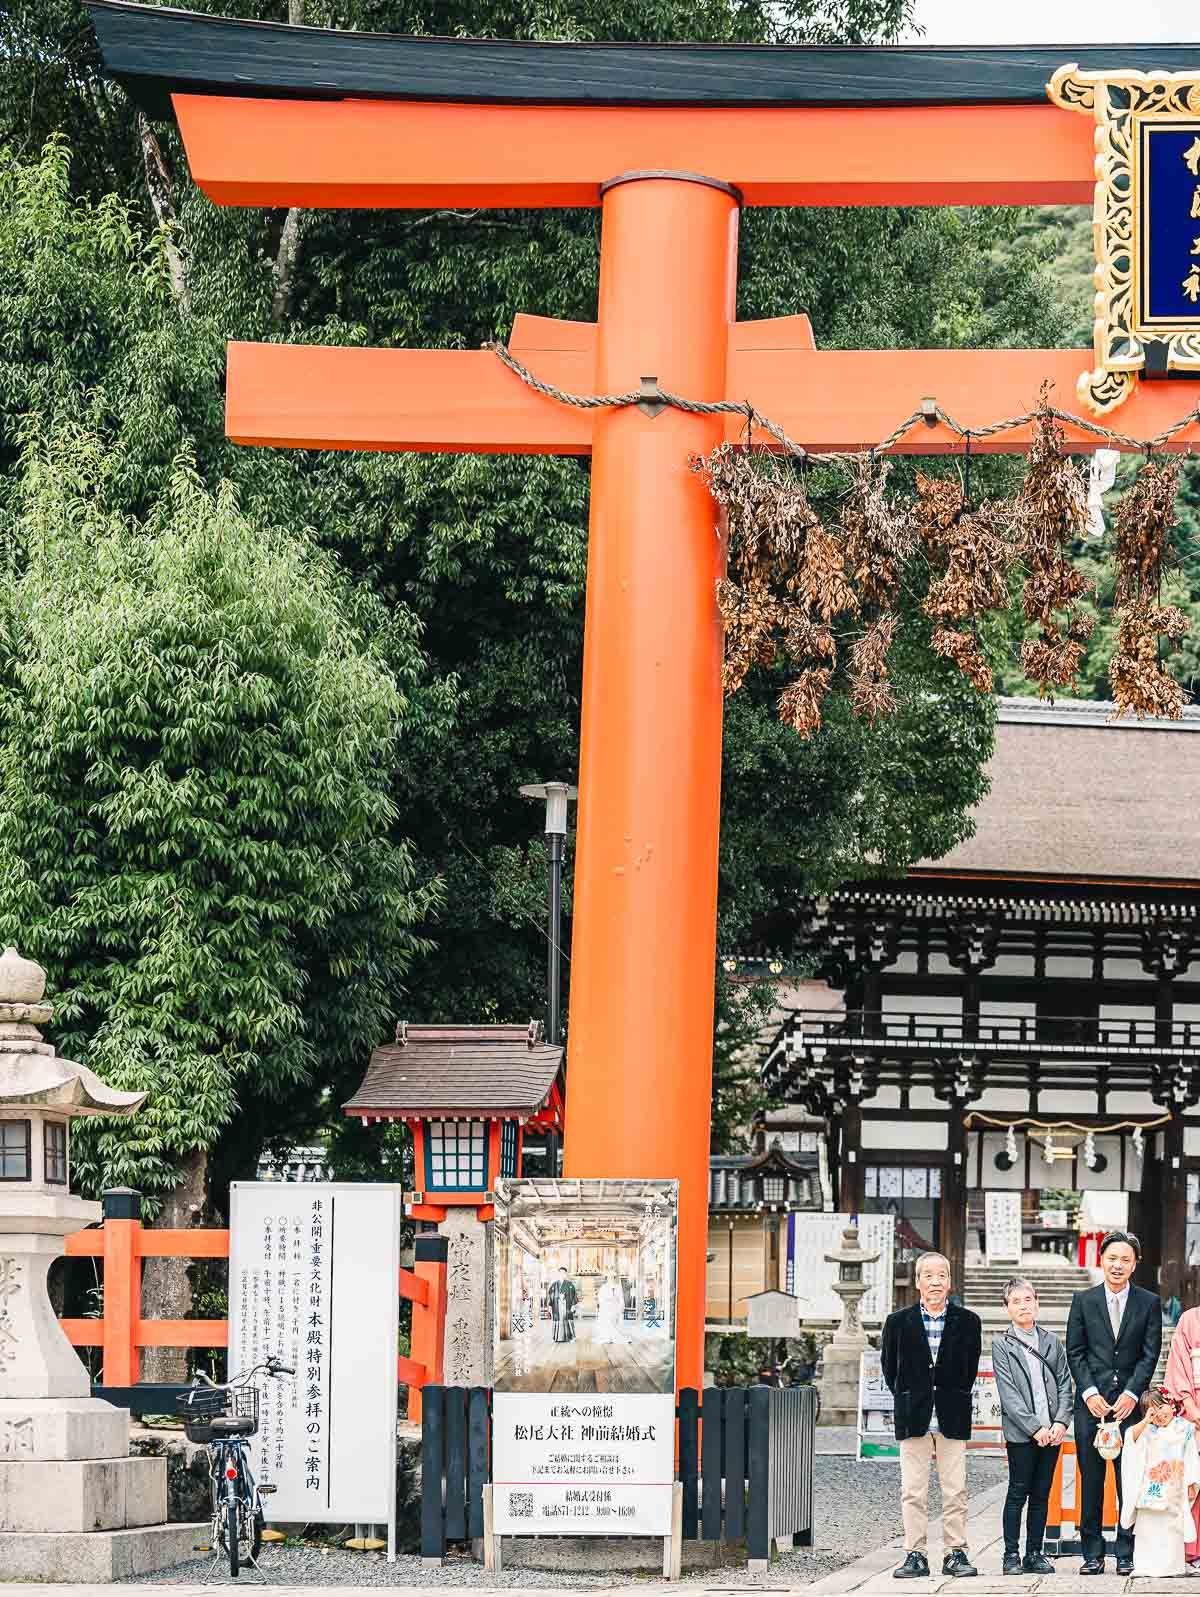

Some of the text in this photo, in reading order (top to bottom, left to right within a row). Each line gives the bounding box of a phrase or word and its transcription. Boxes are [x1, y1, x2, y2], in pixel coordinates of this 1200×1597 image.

[514, 1425, 657, 1441] 松尾大社 神前結婚式
